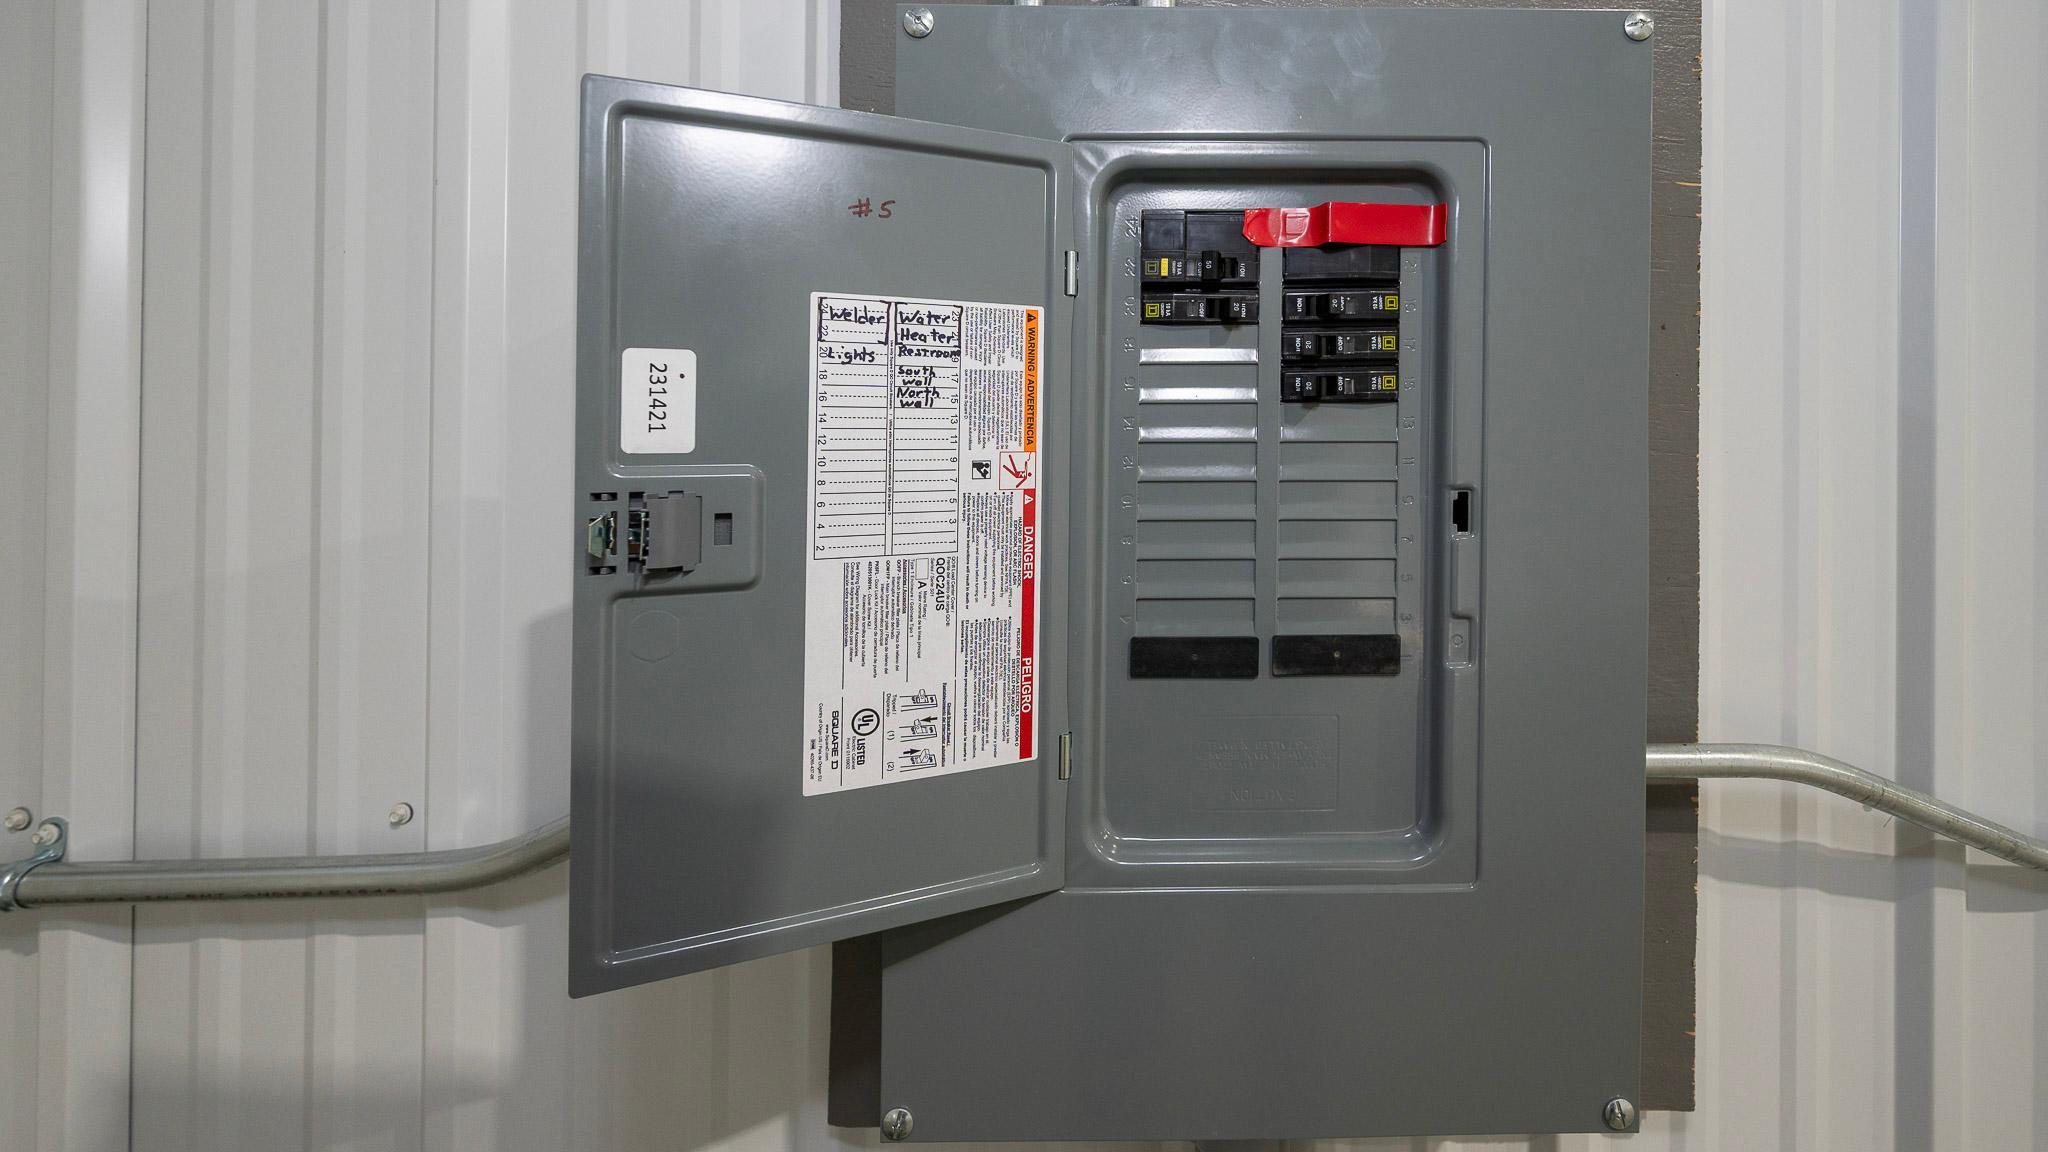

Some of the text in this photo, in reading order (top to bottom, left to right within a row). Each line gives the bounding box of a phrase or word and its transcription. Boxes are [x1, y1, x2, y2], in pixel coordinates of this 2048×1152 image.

[848, 197, 896, 219] #5
[1205, 260, 1212, 269] 50
[1233, 302, 1239, 311] 20
[1332, 299, 1338, 307] 20
[829, 305, 885, 326] Welder
[899, 311, 951, 325] Water
[952, 311, 958, 322] 23
[820, 325, 828, 336] 22
[900, 328, 953, 344] Heater
[1027, 327, 1036, 371] WARNING
[1305, 340, 1312, 349] 20
[819, 347, 828, 358] 20
[828, 346, 875, 364] Lights
[819, 369, 827, 380] 18
[951, 373, 958, 383] 17
[1306, 381, 1312, 390] 20
[648, 363, 667, 433] 231421
[819, 391, 827, 401] 16
[897, 387, 940, 399] North
[951, 394, 958, 404] 15
[1027, 379, 1035, 445] ADVERTENCIA
[819, 413, 827, 423] 14
[951, 415, 958, 424] 13
[818, 434, 826, 445] 12
[950, 434, 957, 444] 11
[818, 455, 826, 467] 10
[1023, 526, 1034, 580] DANGER
[917, 581, 927, 589] A
[936, 557, 945, 611] QOC24US
[1022, 657, 1032, 713] PELIGRO
[887, 730, 895, 741] (1)
[856, 738, 866, 766] LISTED
[831, 760, 839, 770] D
[886, 761, 894, 772] (2)
